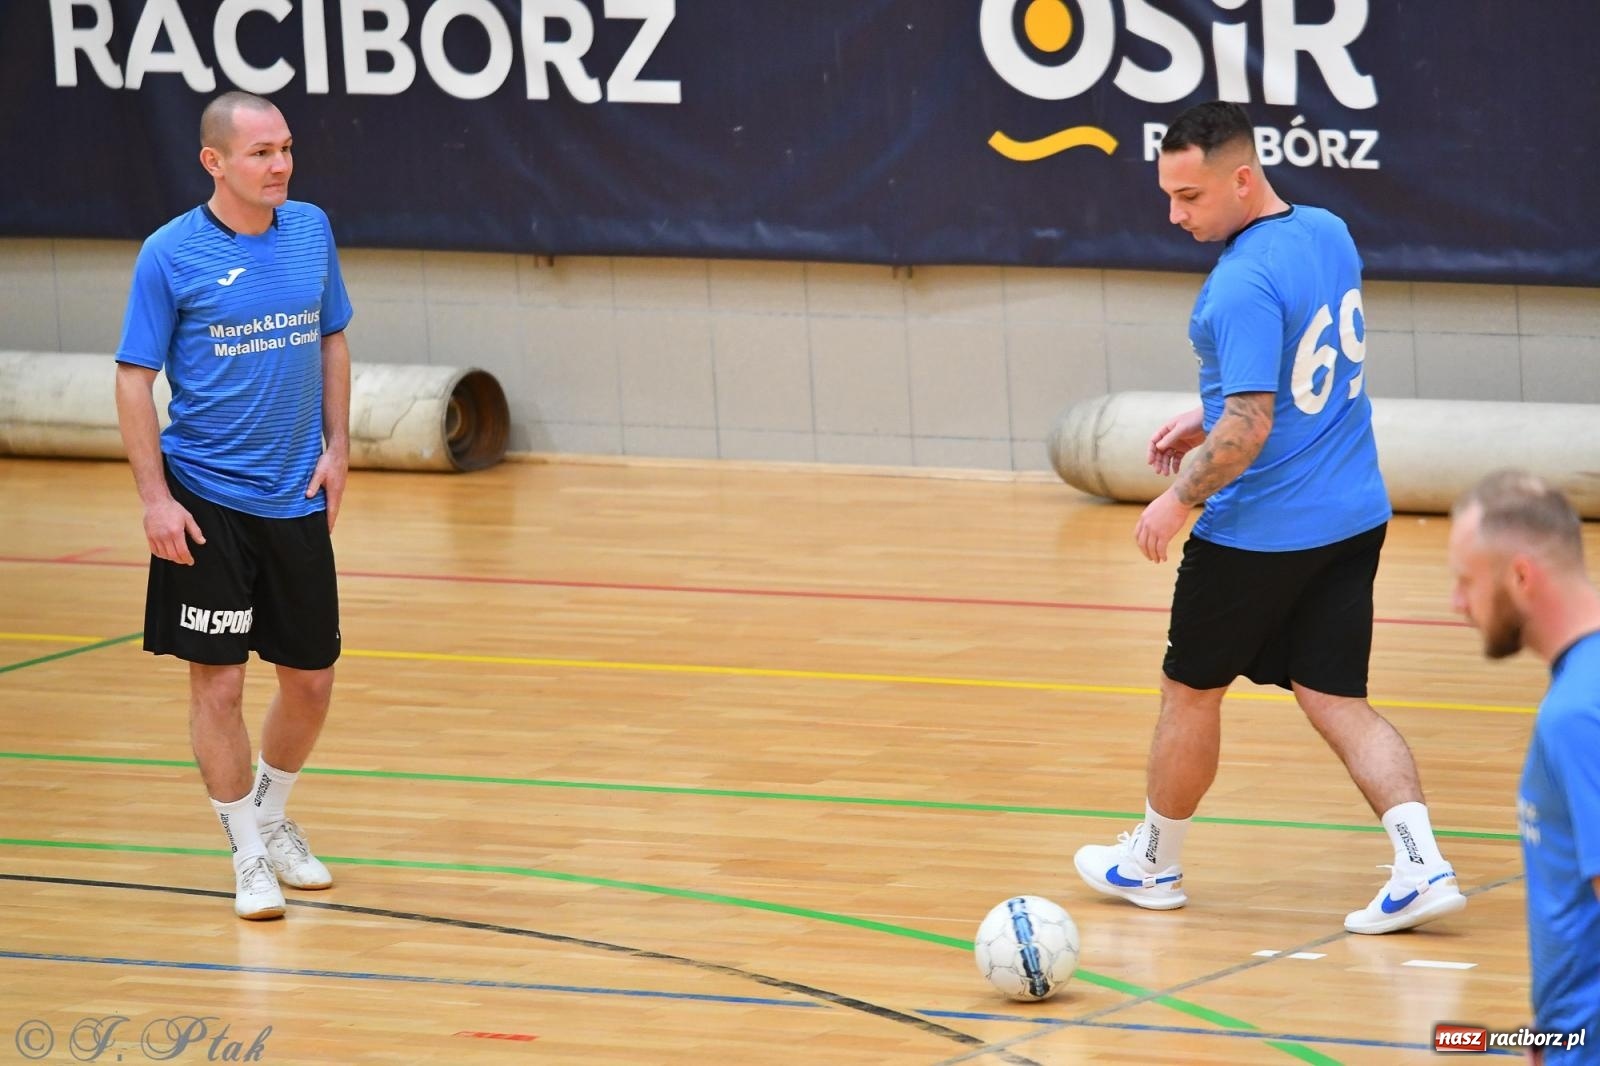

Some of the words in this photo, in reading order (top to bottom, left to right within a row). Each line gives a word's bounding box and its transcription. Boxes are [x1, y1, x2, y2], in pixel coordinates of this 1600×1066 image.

[1144, 116, 1380, 170] RBÓRZ
[209, 309, 321, 338] Marek&Darius
[214, 336, 286, 357] Metallbau
[1291, 288, 1367, 415] 69
[180, 603, 211, 633] LSM
[209, 607, 253, 635] SPOR
